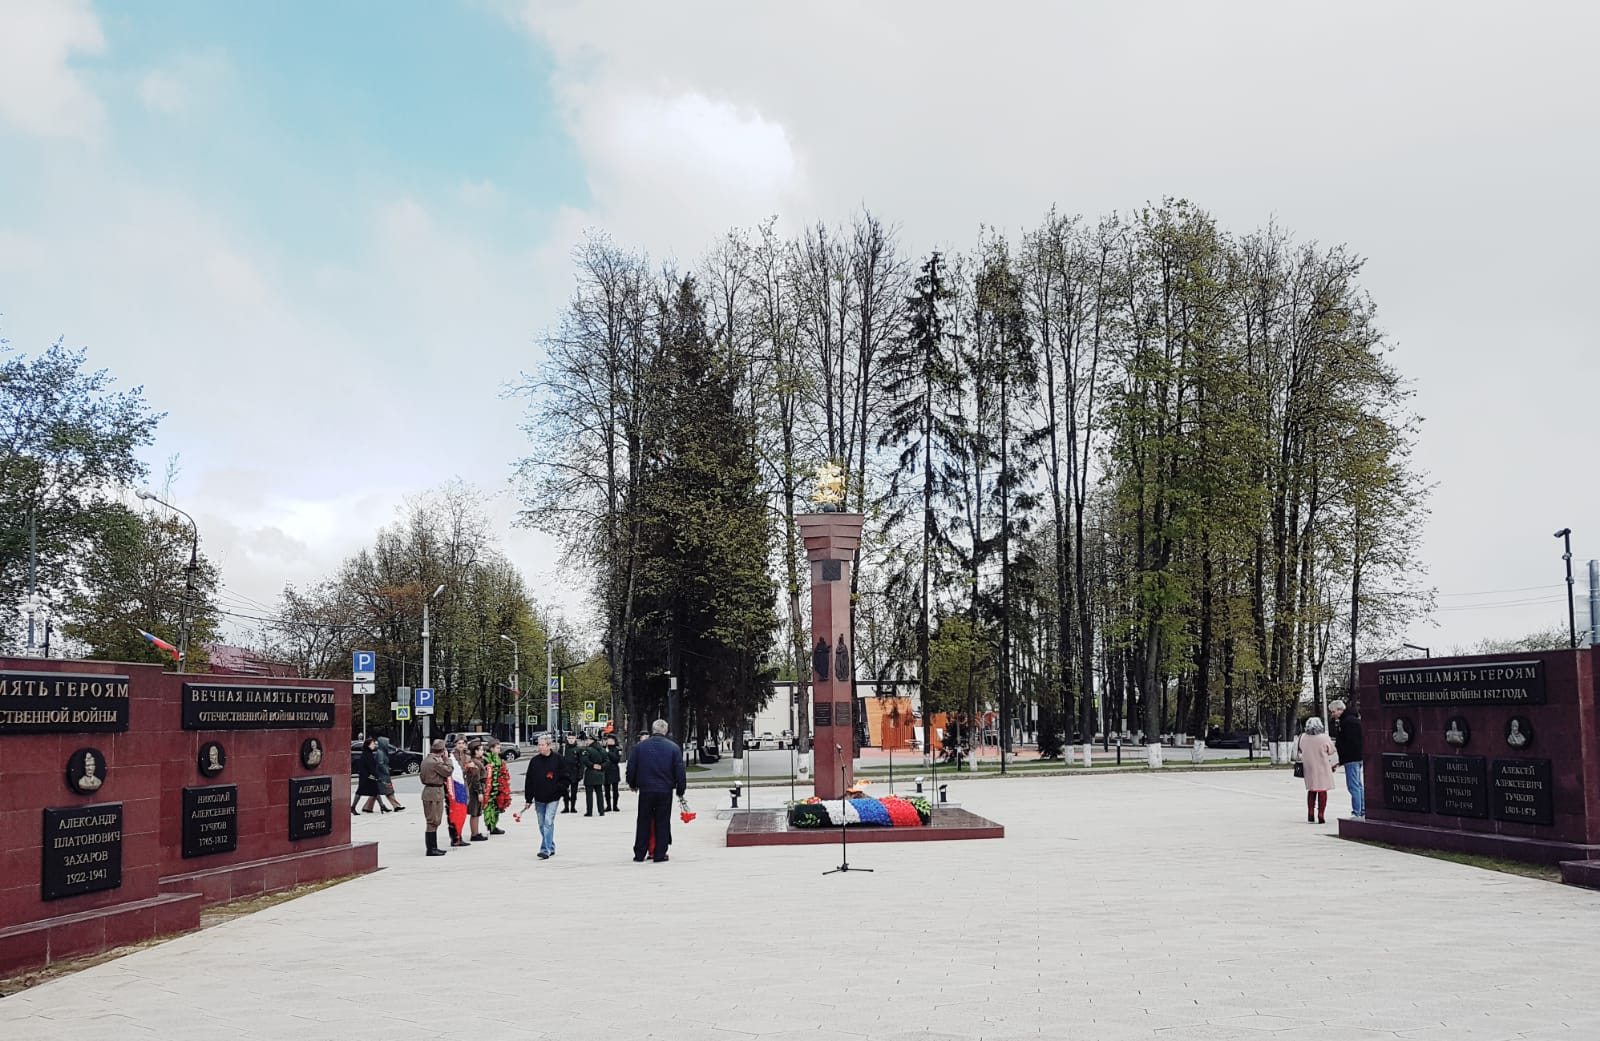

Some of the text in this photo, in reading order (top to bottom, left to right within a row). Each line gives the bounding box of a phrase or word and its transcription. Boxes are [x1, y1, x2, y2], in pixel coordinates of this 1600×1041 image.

[359, 653, 371, 671] P
[1378, 667, 1536, 685] ВЕЧНАЯ ПАМЯТЬ ГЕРОЯМ
[54, 681, 129, 698] ГЕРОЯМ
[191, 690, 335, 704] ВЕЧНАЯ ПАМЯТЬ ГЕРОЯМ
[420, 690, 431, 705] P
[1450, 687, 1481, 700] ВОЙНЫ
[1501, 688, 1528, 699] ГОДА
[71, 706, 118, 723] ВОЙНЫ
[59, 814, 117, 830] АЛЕКСАНДР
[53, 830, 121, 849] ПЛАТОНОВИЧ
[63, 850, 109, 867] ЗАХАРОВ
[66, 868, 107, 885] 1922-1941
